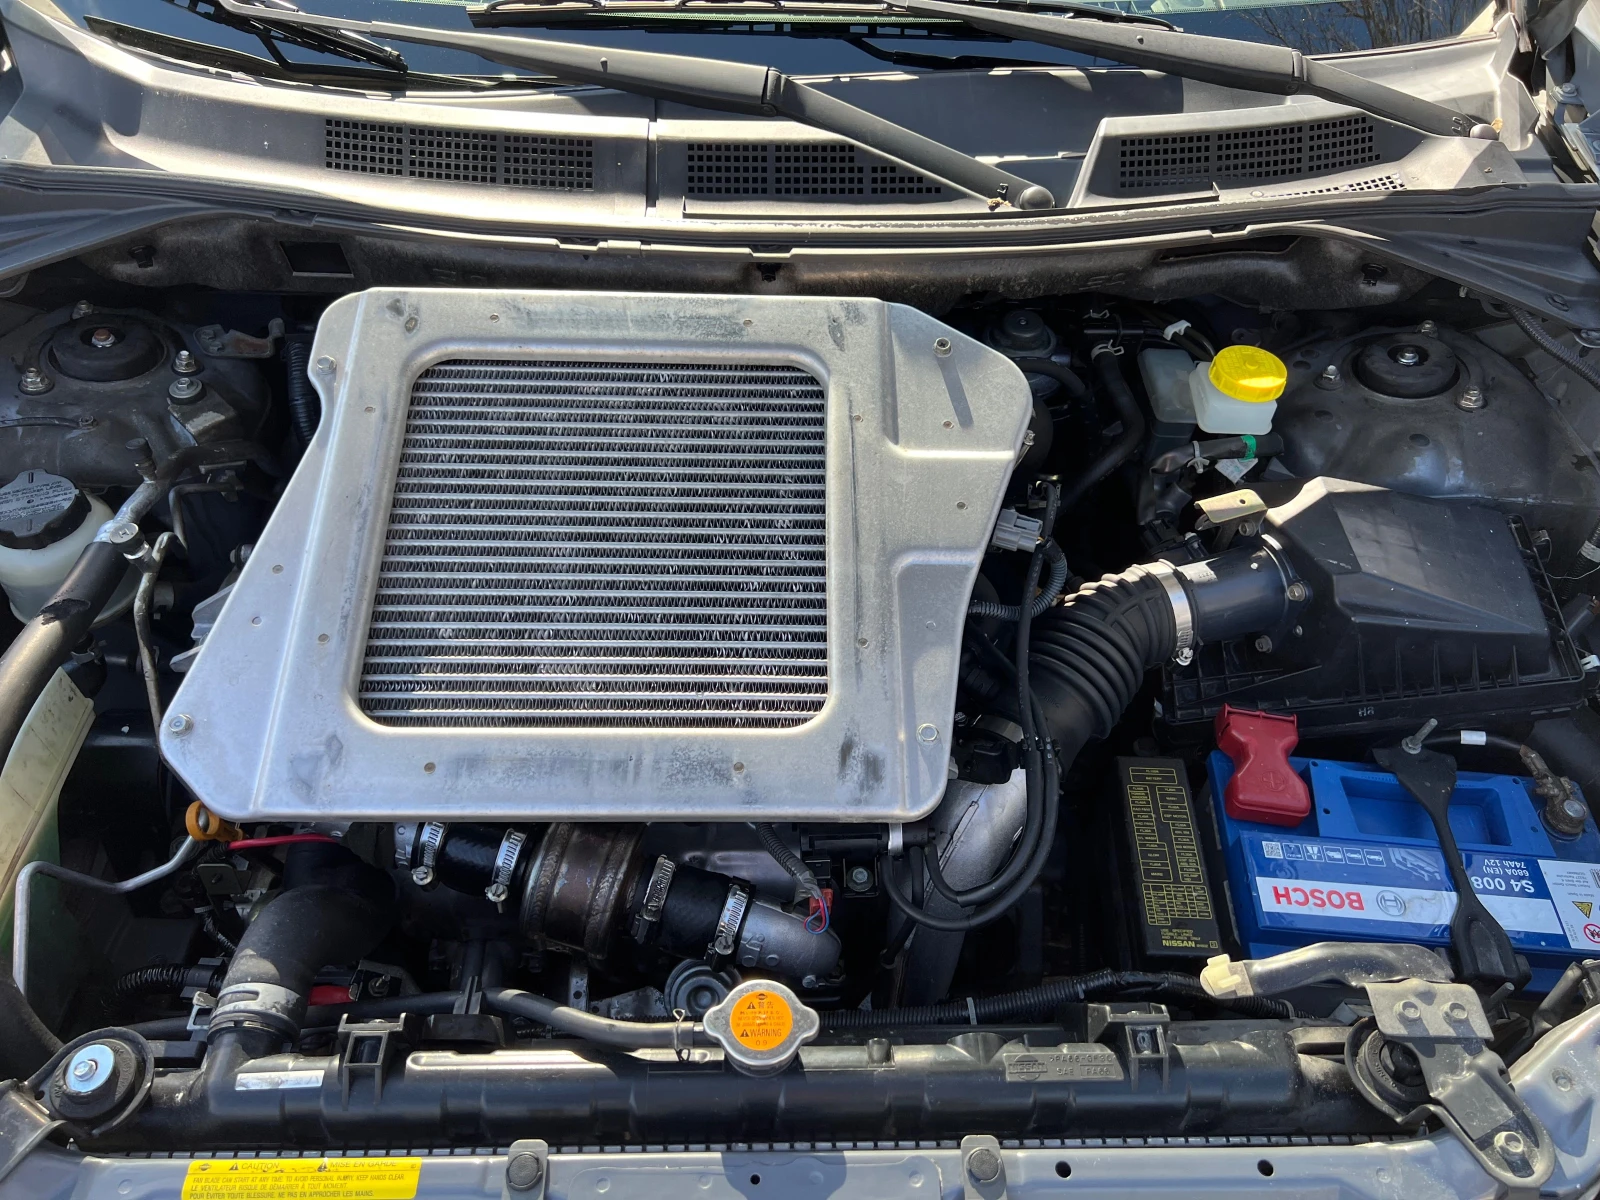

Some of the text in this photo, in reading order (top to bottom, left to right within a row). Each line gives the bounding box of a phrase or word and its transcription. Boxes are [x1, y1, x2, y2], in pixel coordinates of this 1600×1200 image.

[1484, 859, 1526, 869] 74Ah 12V
[1482, 865, 1529, 877] 680A (EN)
[1470, 876, 1535, 893] S4 008
[1272, 886, 1365, 911] BOSCH
[750, 1029, 782, 1037] WARNING
